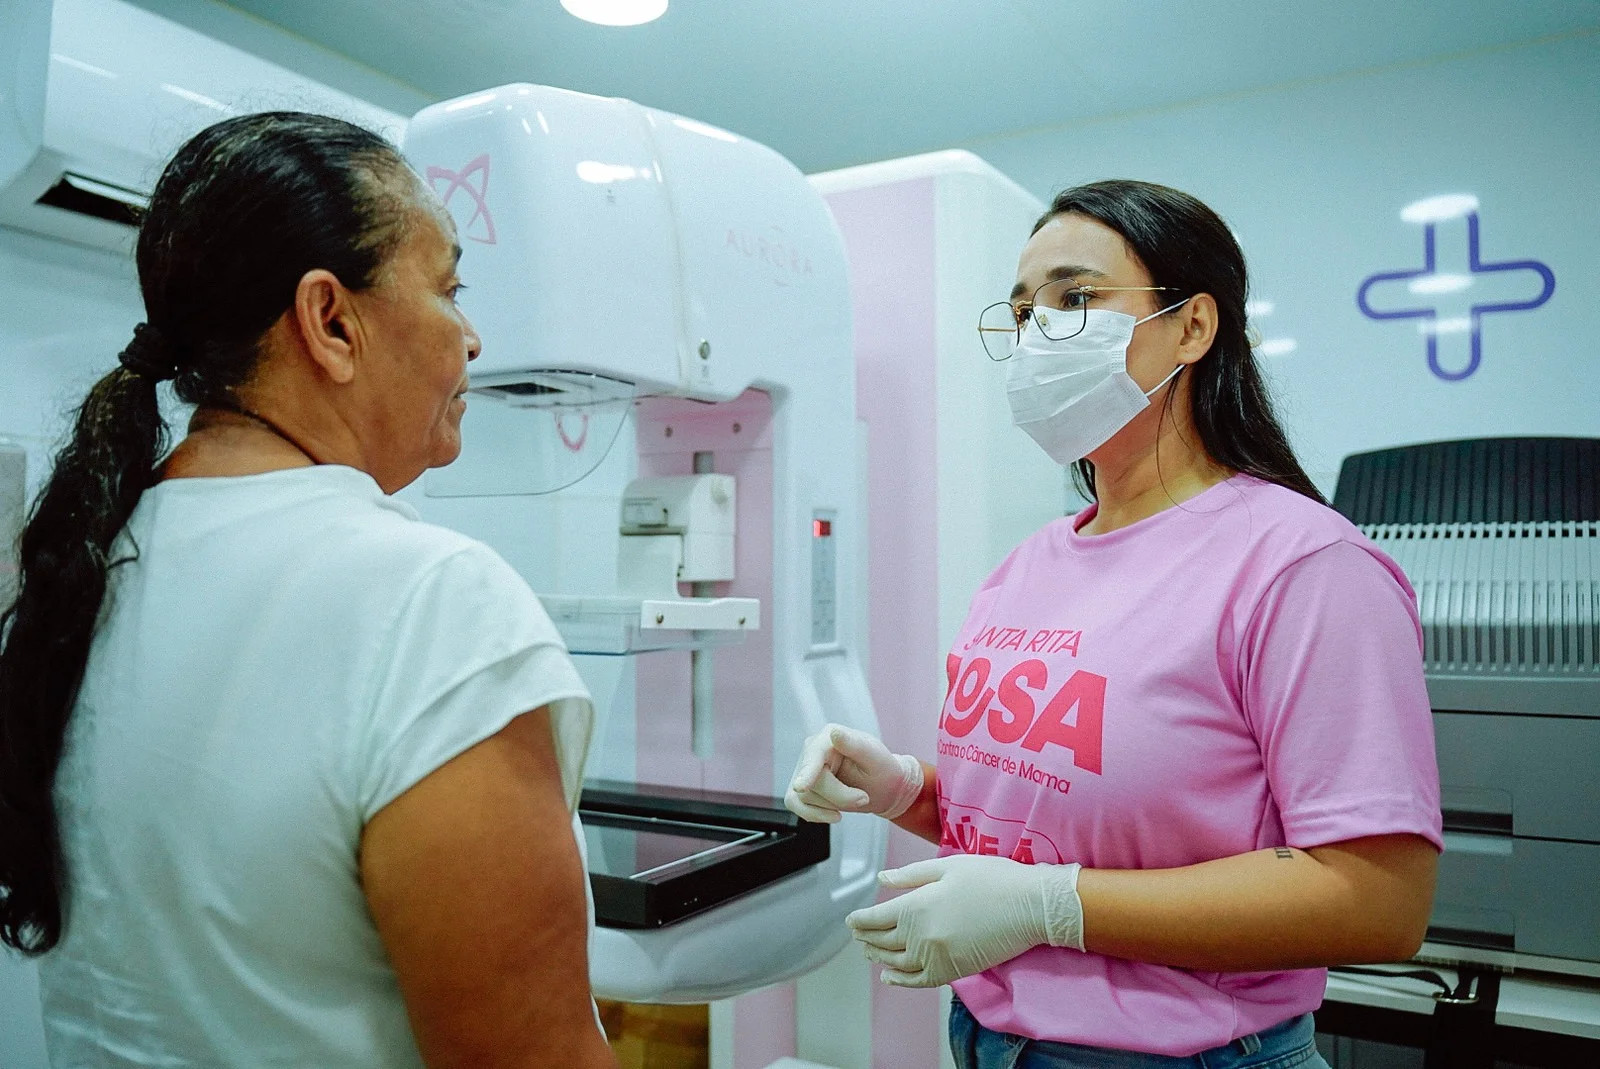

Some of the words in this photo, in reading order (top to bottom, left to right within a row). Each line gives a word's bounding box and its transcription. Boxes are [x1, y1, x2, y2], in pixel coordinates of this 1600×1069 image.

[964, 624, 1028, 651] ANTA
[1023, 629, 1083, 658] RITA
[960, 746, 966, 759] o
[966, 744, 1001, 769] Câncer
[1002, 755, 1017, 775] de
[1018, 759, 1071, 795] Mama
